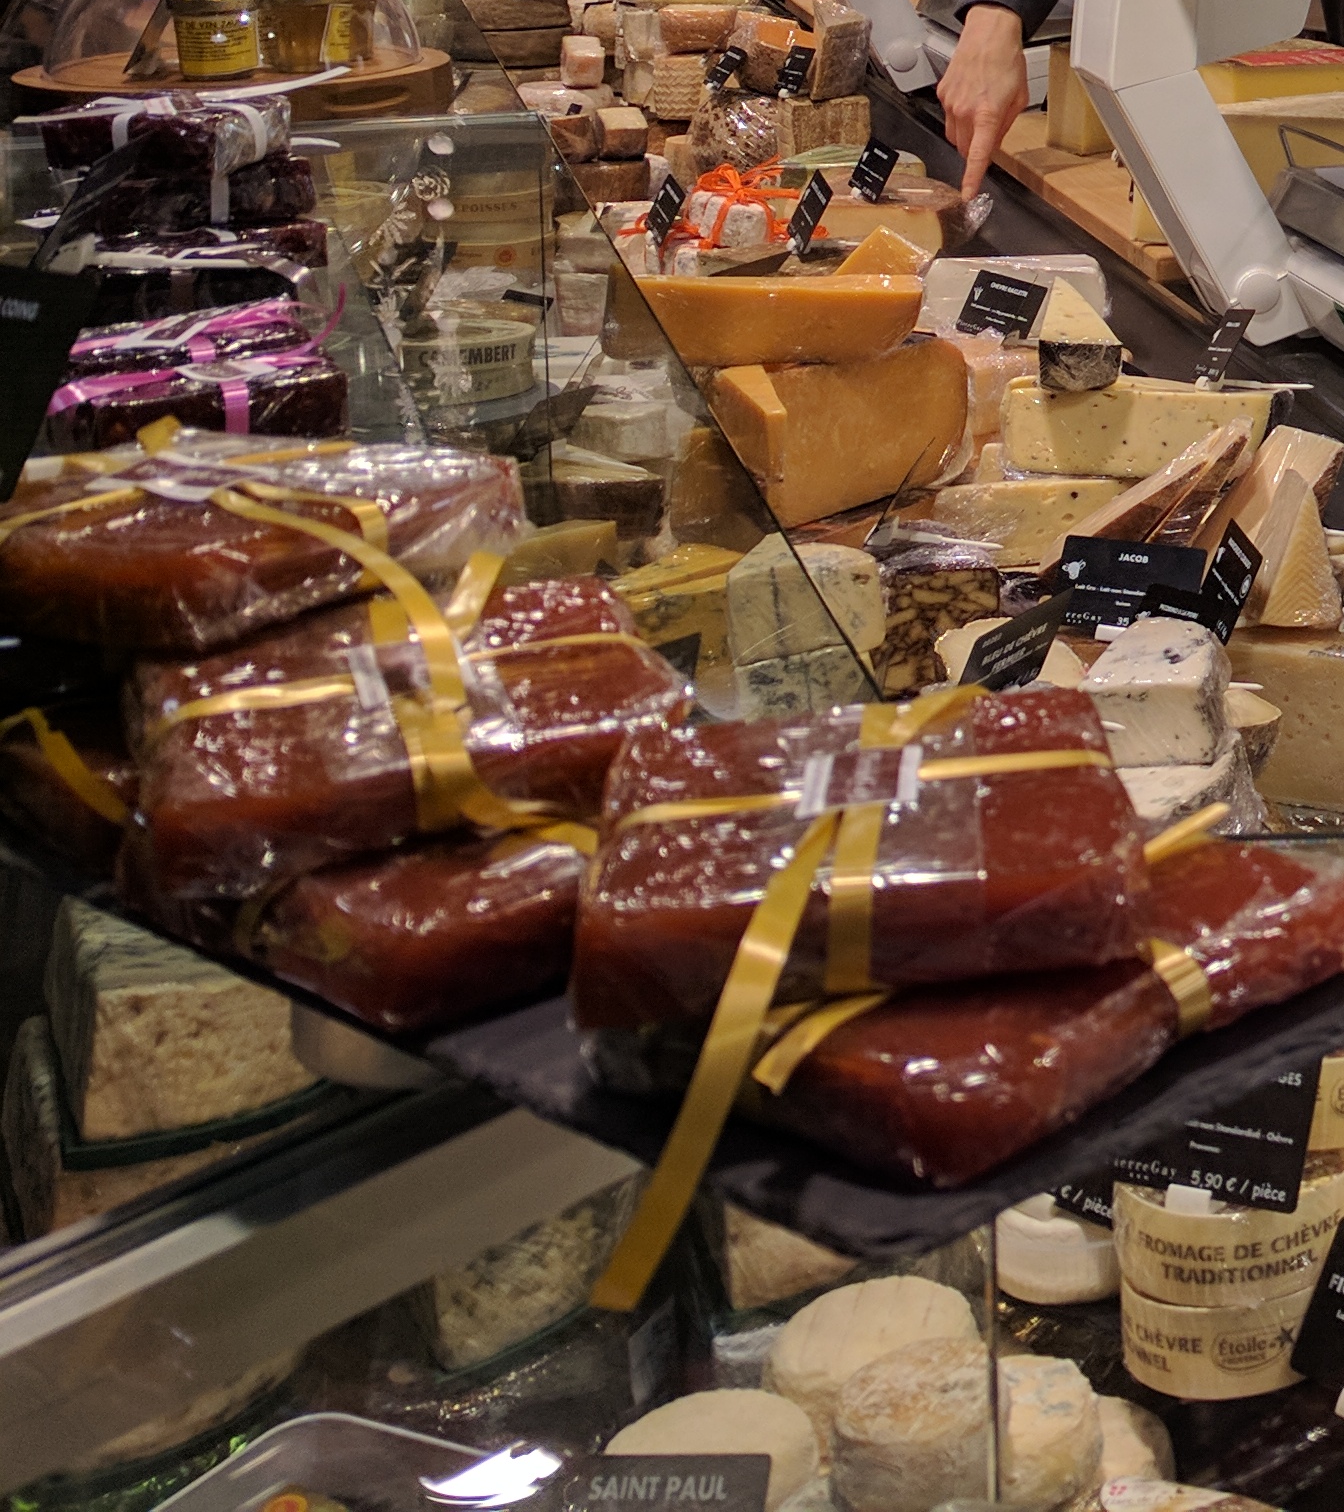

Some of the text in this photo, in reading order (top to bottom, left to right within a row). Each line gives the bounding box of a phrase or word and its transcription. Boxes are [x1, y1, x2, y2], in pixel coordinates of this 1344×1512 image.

[456, 202, 517, 215] POISSES
[1118, 552, 1149, 564] JACOB
[1225, 1178, 1237, 1192] €
[1252, 1182, 1286, 1203] pièce
[1137, 1209, 1340, 1263] FROMAGE DE CHÈVRE
[1161, 1247, 1318, 1285] TRADITIONNEL
[1135, 1321, 1203, 1355] CHÈVRE
[1217, 1335, 1267, 1356] Étoile
[588, 1475, 728, 1501] SAINT PAUL
